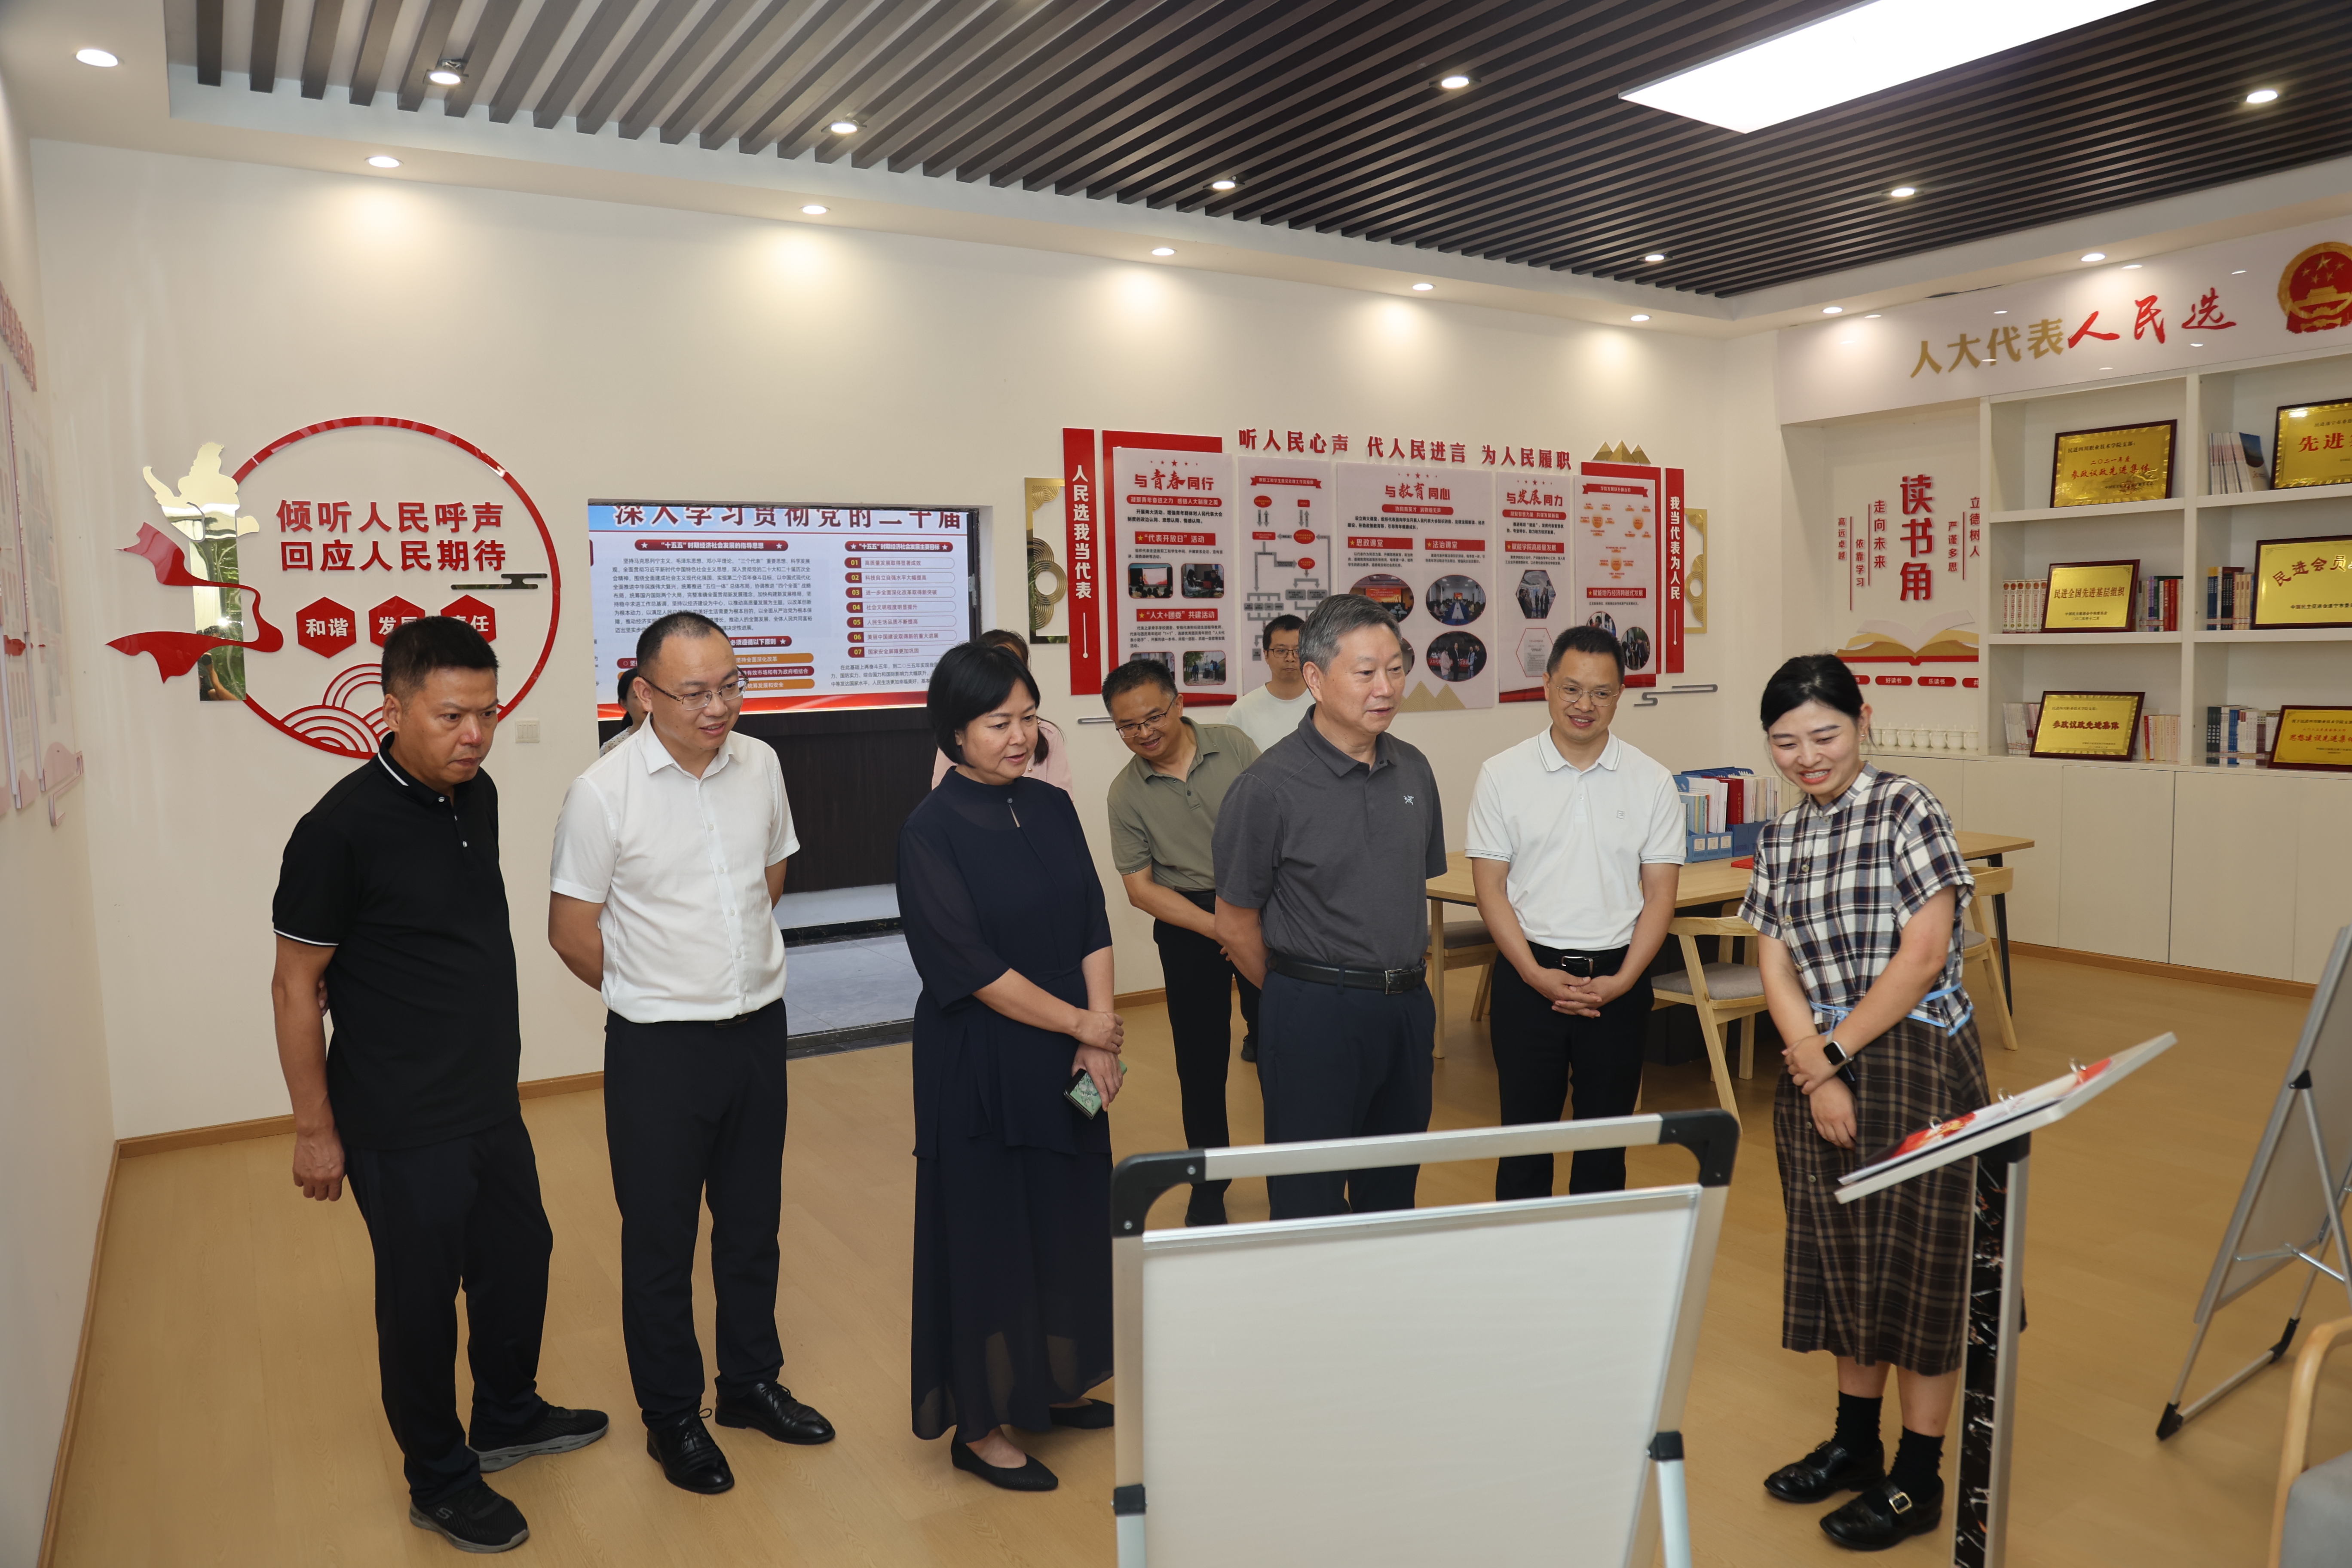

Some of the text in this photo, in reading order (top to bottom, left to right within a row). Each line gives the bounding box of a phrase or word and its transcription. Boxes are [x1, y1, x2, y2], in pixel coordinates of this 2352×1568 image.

[1910, 287, 2238, 379] 人大代表人民选
[1239, 429, 1571, 470] 听人民心声 代人民进言 为人民履职
[2298, 432, 2352, 453] 先进
[1135, 469, 1214, 490] 与青春同行
[2071, 463, 2150, 480] 参政议政先进集体
[1385, 482, 1450, 500] 与教育同心
[1507, 489, 1562, 506] 与发展同力
[276, 499, 504, 533] 倾听人民呼声
[1072, 465, 1092, 599] 人民选我当代表
[1969, 497, 1980, 558] 立德树人
[1357, 539, 1383, 547] 思政课堂
[1512, 543, 1556, 551] 赋能学院高质量发展
[1670, 496, 1680, 600] 我当代表为人民
[1874, 500, 1886, 569] 走向未来
[1900, 474, 1933, 601] 读书角
[1948, 521, 1957, 573] 严谨多思
[280, 539, 506, 572] 回应人民期待
[1856, 539, 1865, 587] 依靠学习
[2272, 555, 2352, 587] 民进会员
[2054, 587, 2125, 599] 民进全国先进基层组织
[306, 618, 349, 637] 和谐
[1146, 611, 1185, 619] “人大+团委”
[2053, 720, 2119, 730] 参政议政先进集体
